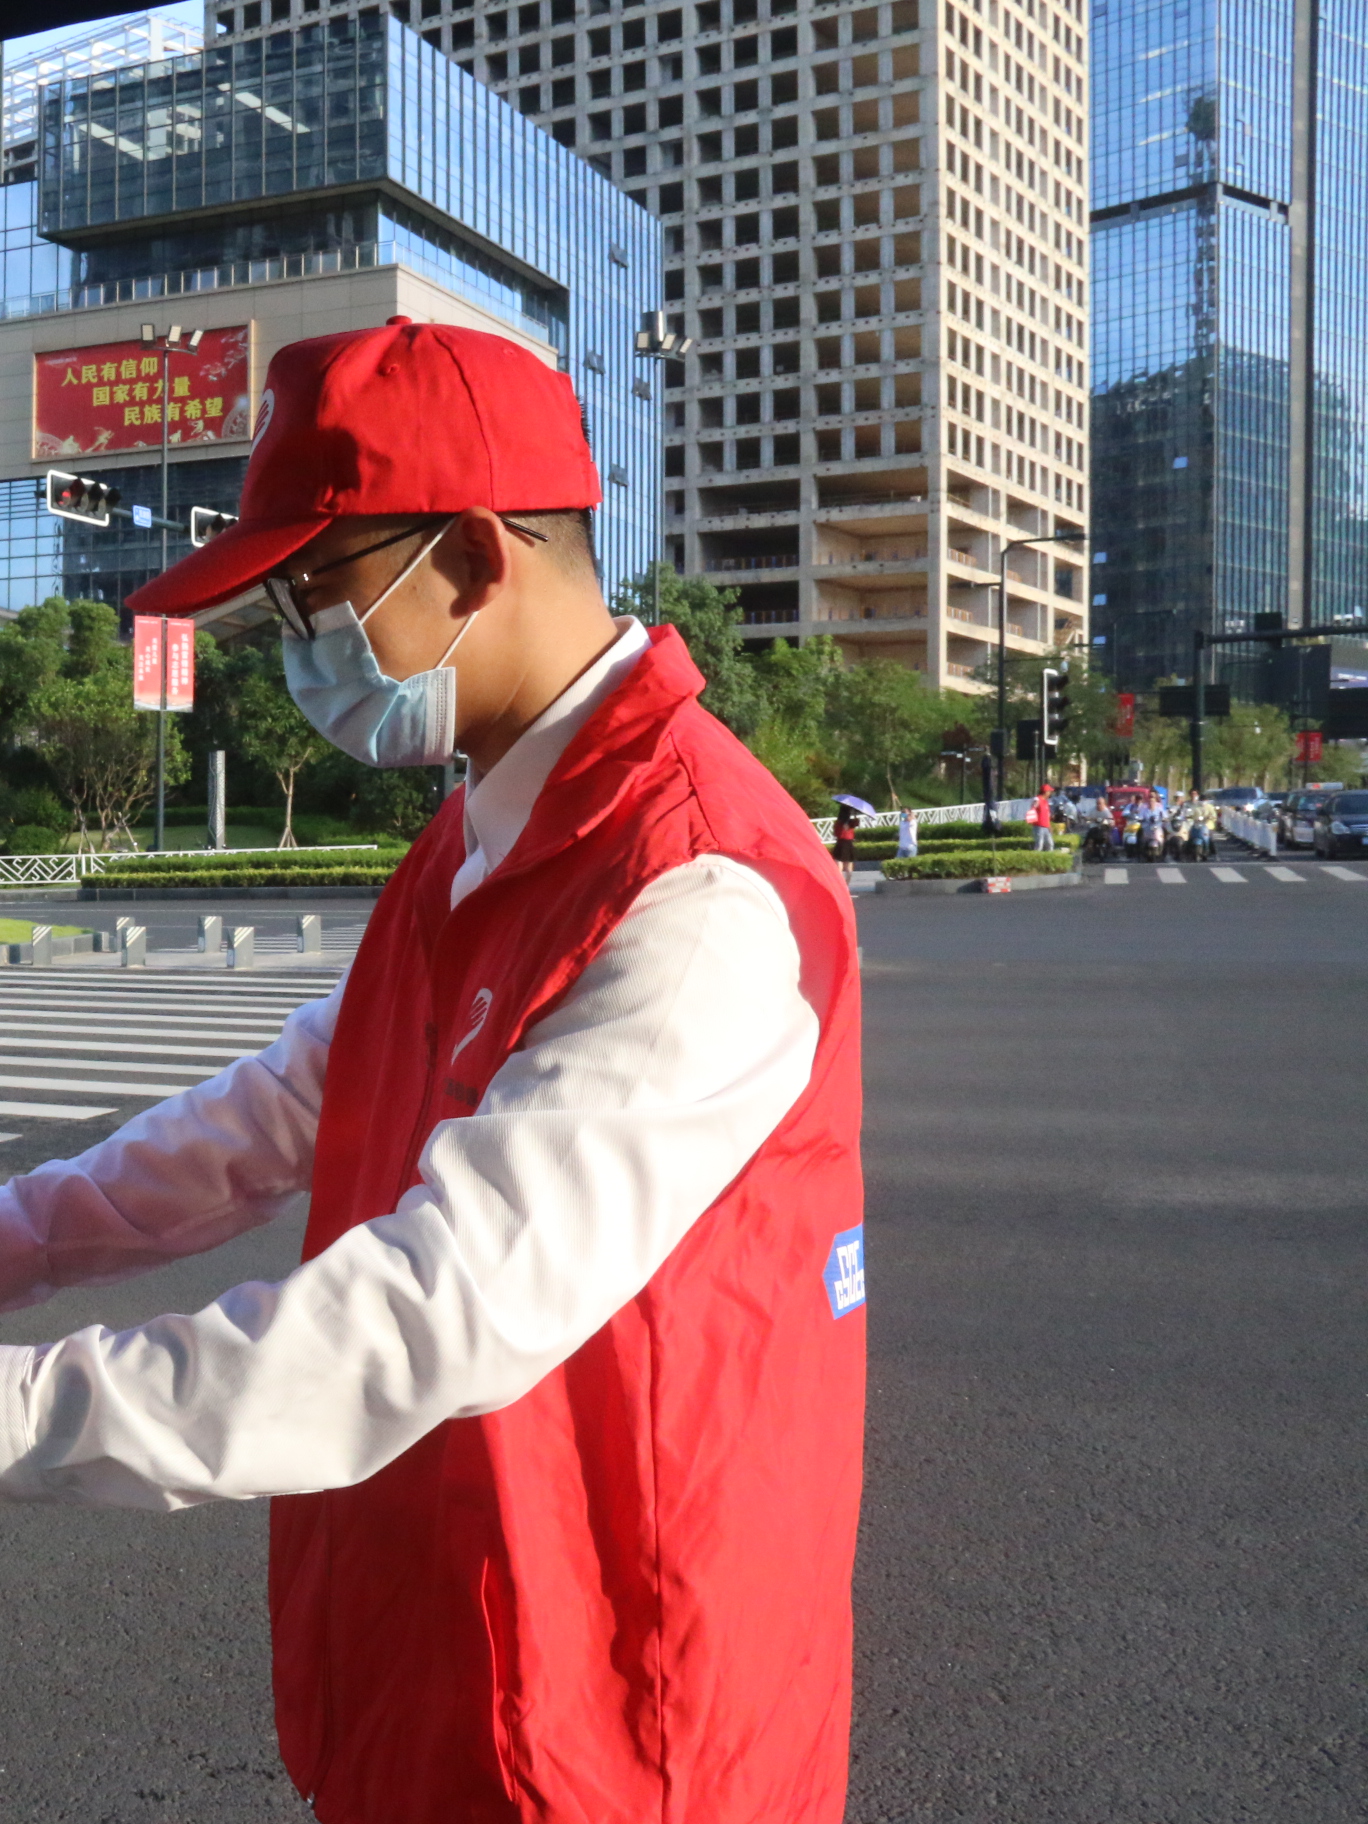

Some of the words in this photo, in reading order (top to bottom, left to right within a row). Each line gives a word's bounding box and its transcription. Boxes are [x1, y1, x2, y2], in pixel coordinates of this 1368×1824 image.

[61, 356, 158, 386] 人民有信仰
[93, 376, 190, 407] 国家有力量
[124, 397, 224, 426] 民族有希望
